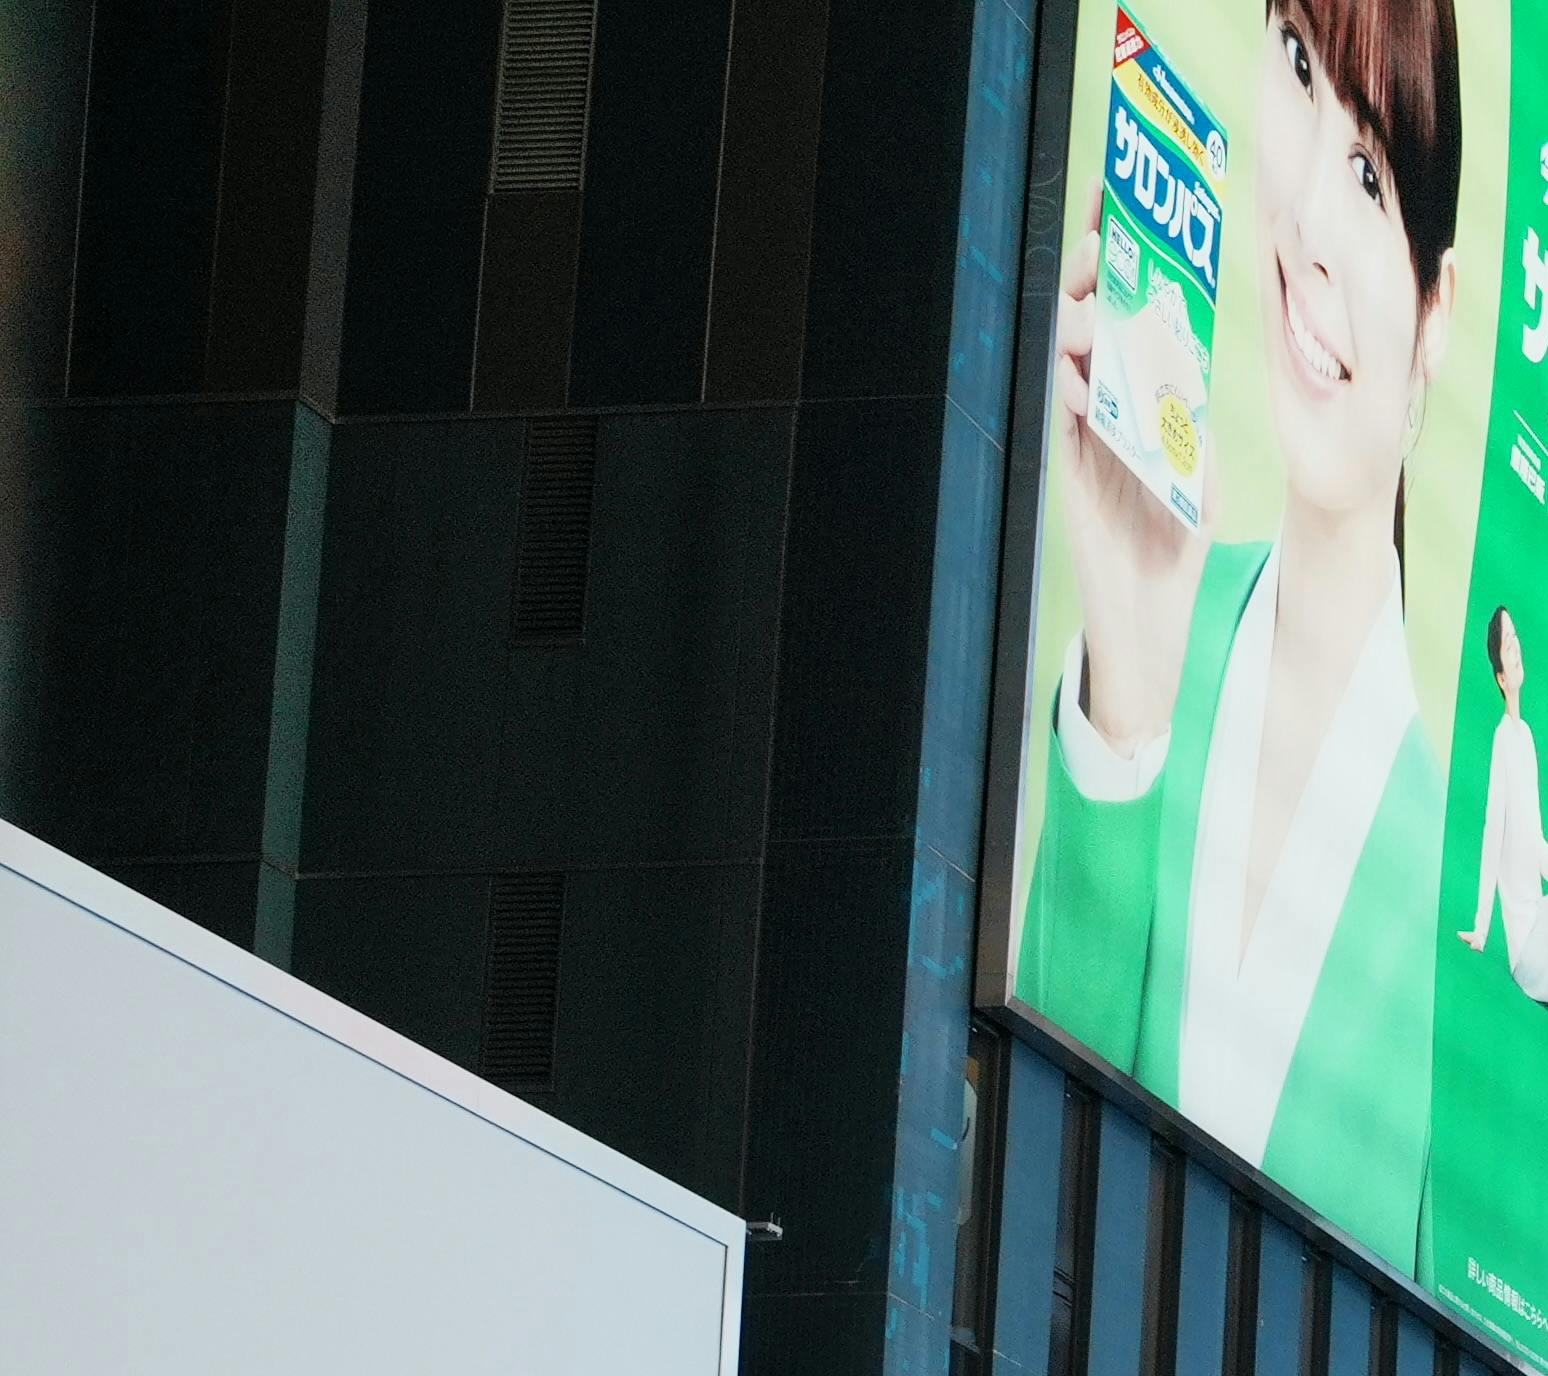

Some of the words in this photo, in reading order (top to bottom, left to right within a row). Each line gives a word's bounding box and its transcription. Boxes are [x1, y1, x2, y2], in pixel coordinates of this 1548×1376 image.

[1114, 105, 1216, 289] サロンパス
